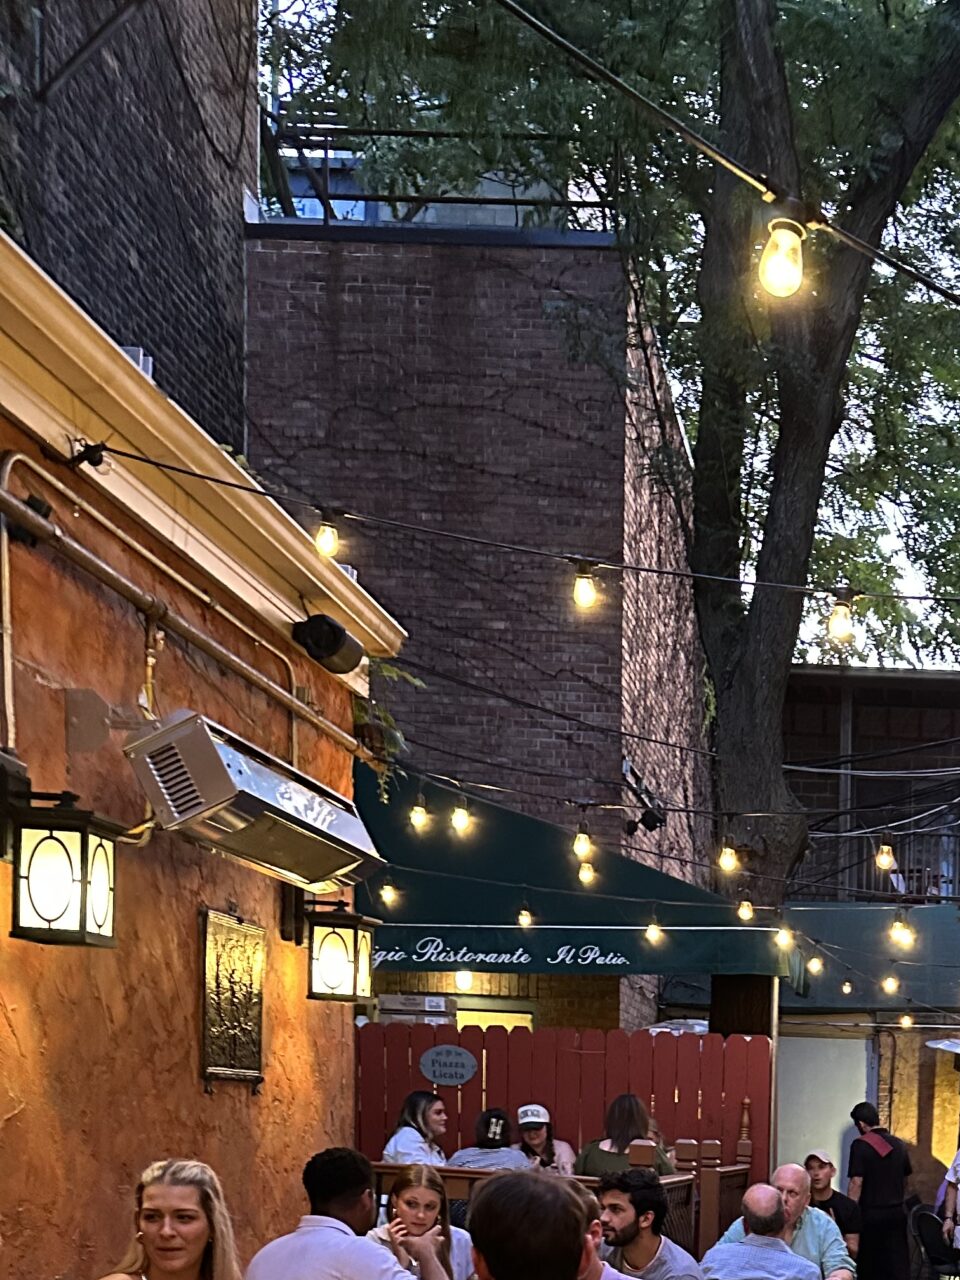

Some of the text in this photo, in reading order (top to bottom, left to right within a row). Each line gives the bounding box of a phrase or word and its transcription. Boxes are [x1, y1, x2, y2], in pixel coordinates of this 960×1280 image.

[412, 936, 532, 965] Ristorante
[547, 945, 576, 965] Il
[578, 945, 630, 965] Patio.
[431, 1058, 466, 1069] Piazza
[432, 1069, 465, 1079] Licata
